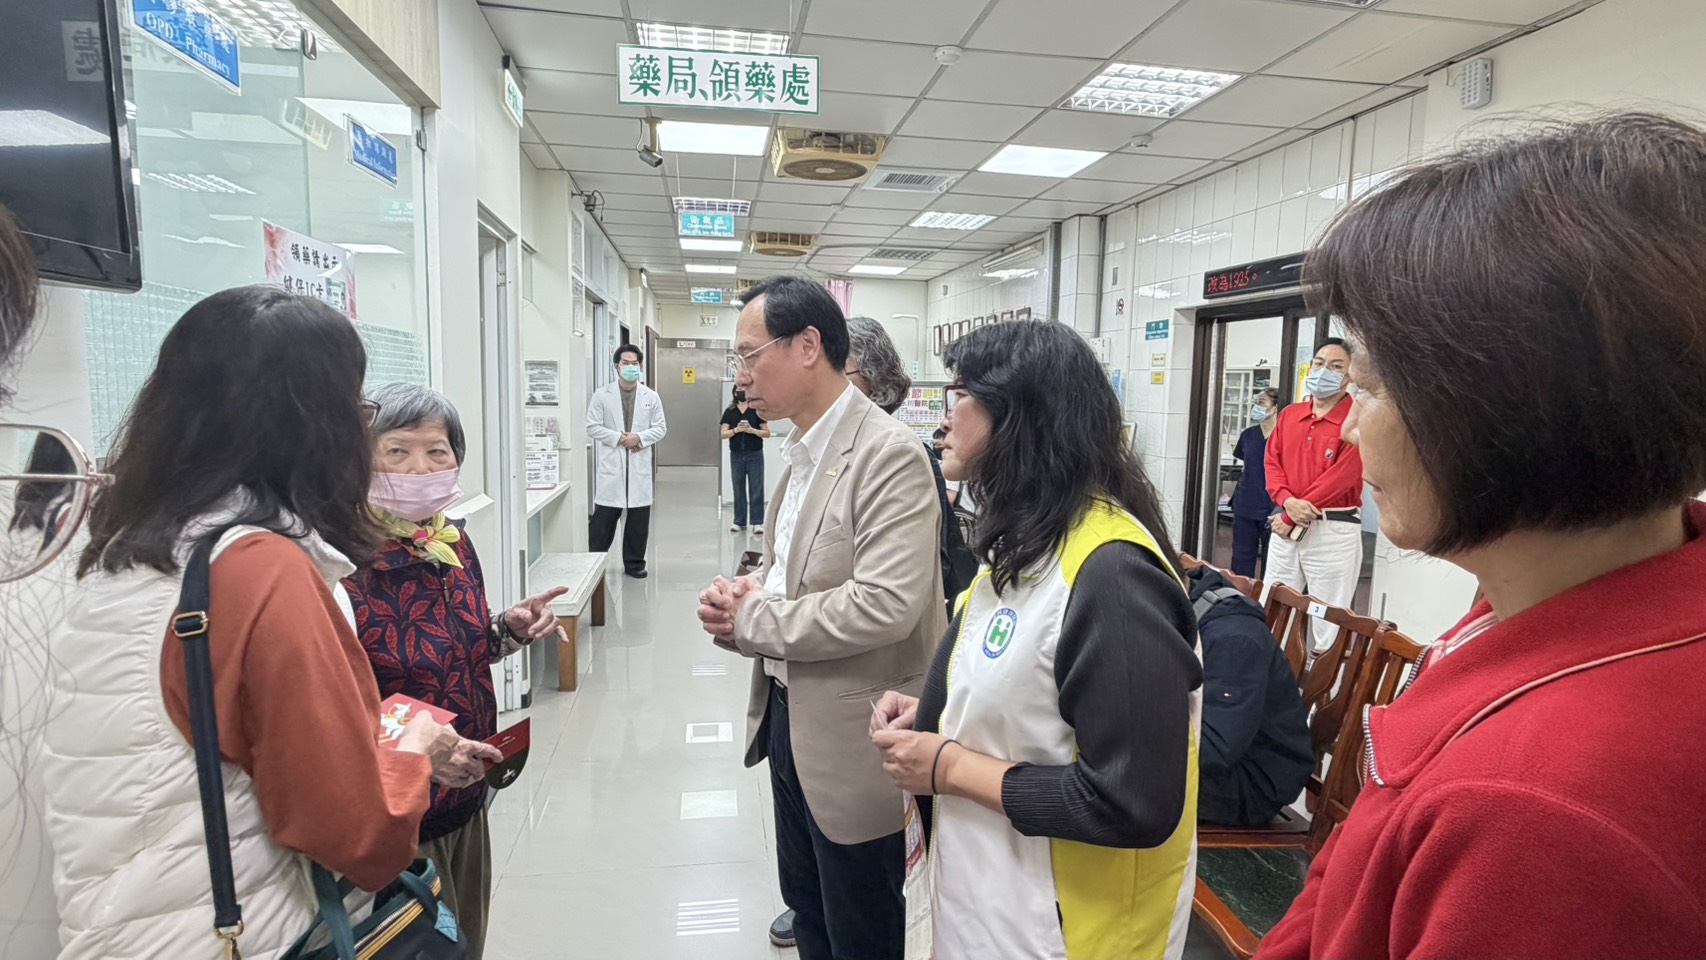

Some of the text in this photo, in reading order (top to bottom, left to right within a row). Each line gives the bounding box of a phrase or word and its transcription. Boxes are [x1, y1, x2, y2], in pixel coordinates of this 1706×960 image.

[146, 12, 174, 40] OPD
[185, 36, 231, 77] Pharmacy
[628, 53, 811, 106] 藥局、領藥處
[291, 242, 339, 269] 領藥請出示
[283, 275, 325, 298] 健保IC卡
